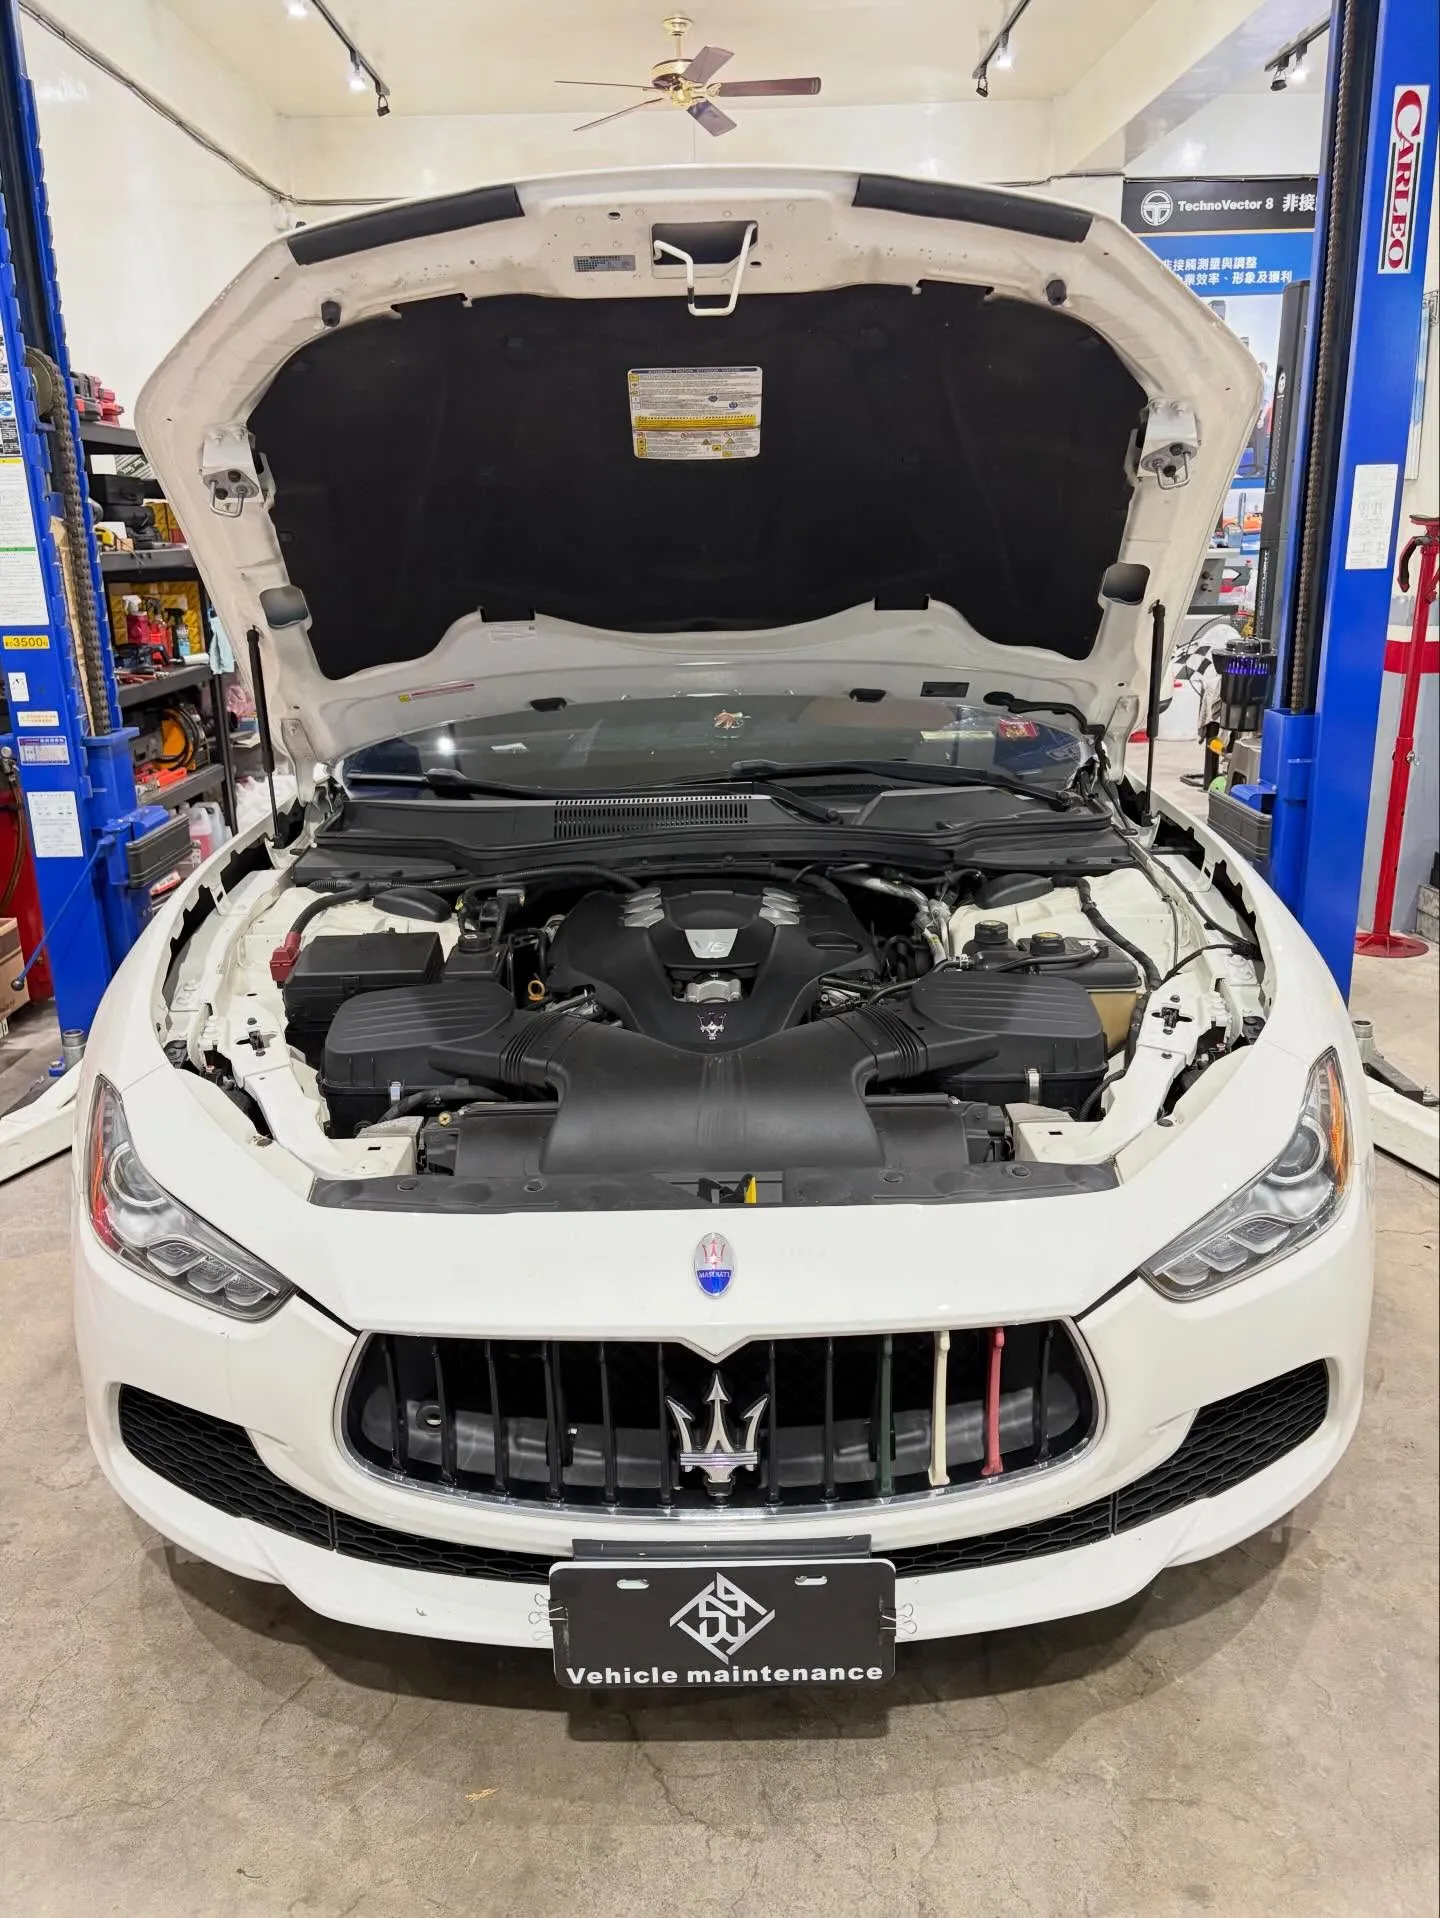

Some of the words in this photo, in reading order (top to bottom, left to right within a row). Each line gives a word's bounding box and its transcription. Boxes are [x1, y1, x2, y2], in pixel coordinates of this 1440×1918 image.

[1387, 90, 1422, 269] CARLEO
[1178, 199, 1263, 212] TechnoVector
[1265, 198, 1274, 210] 8
[566, 1667, 678, 1685] Vehicle
[687, 1665, 884, 1683] maintenance
